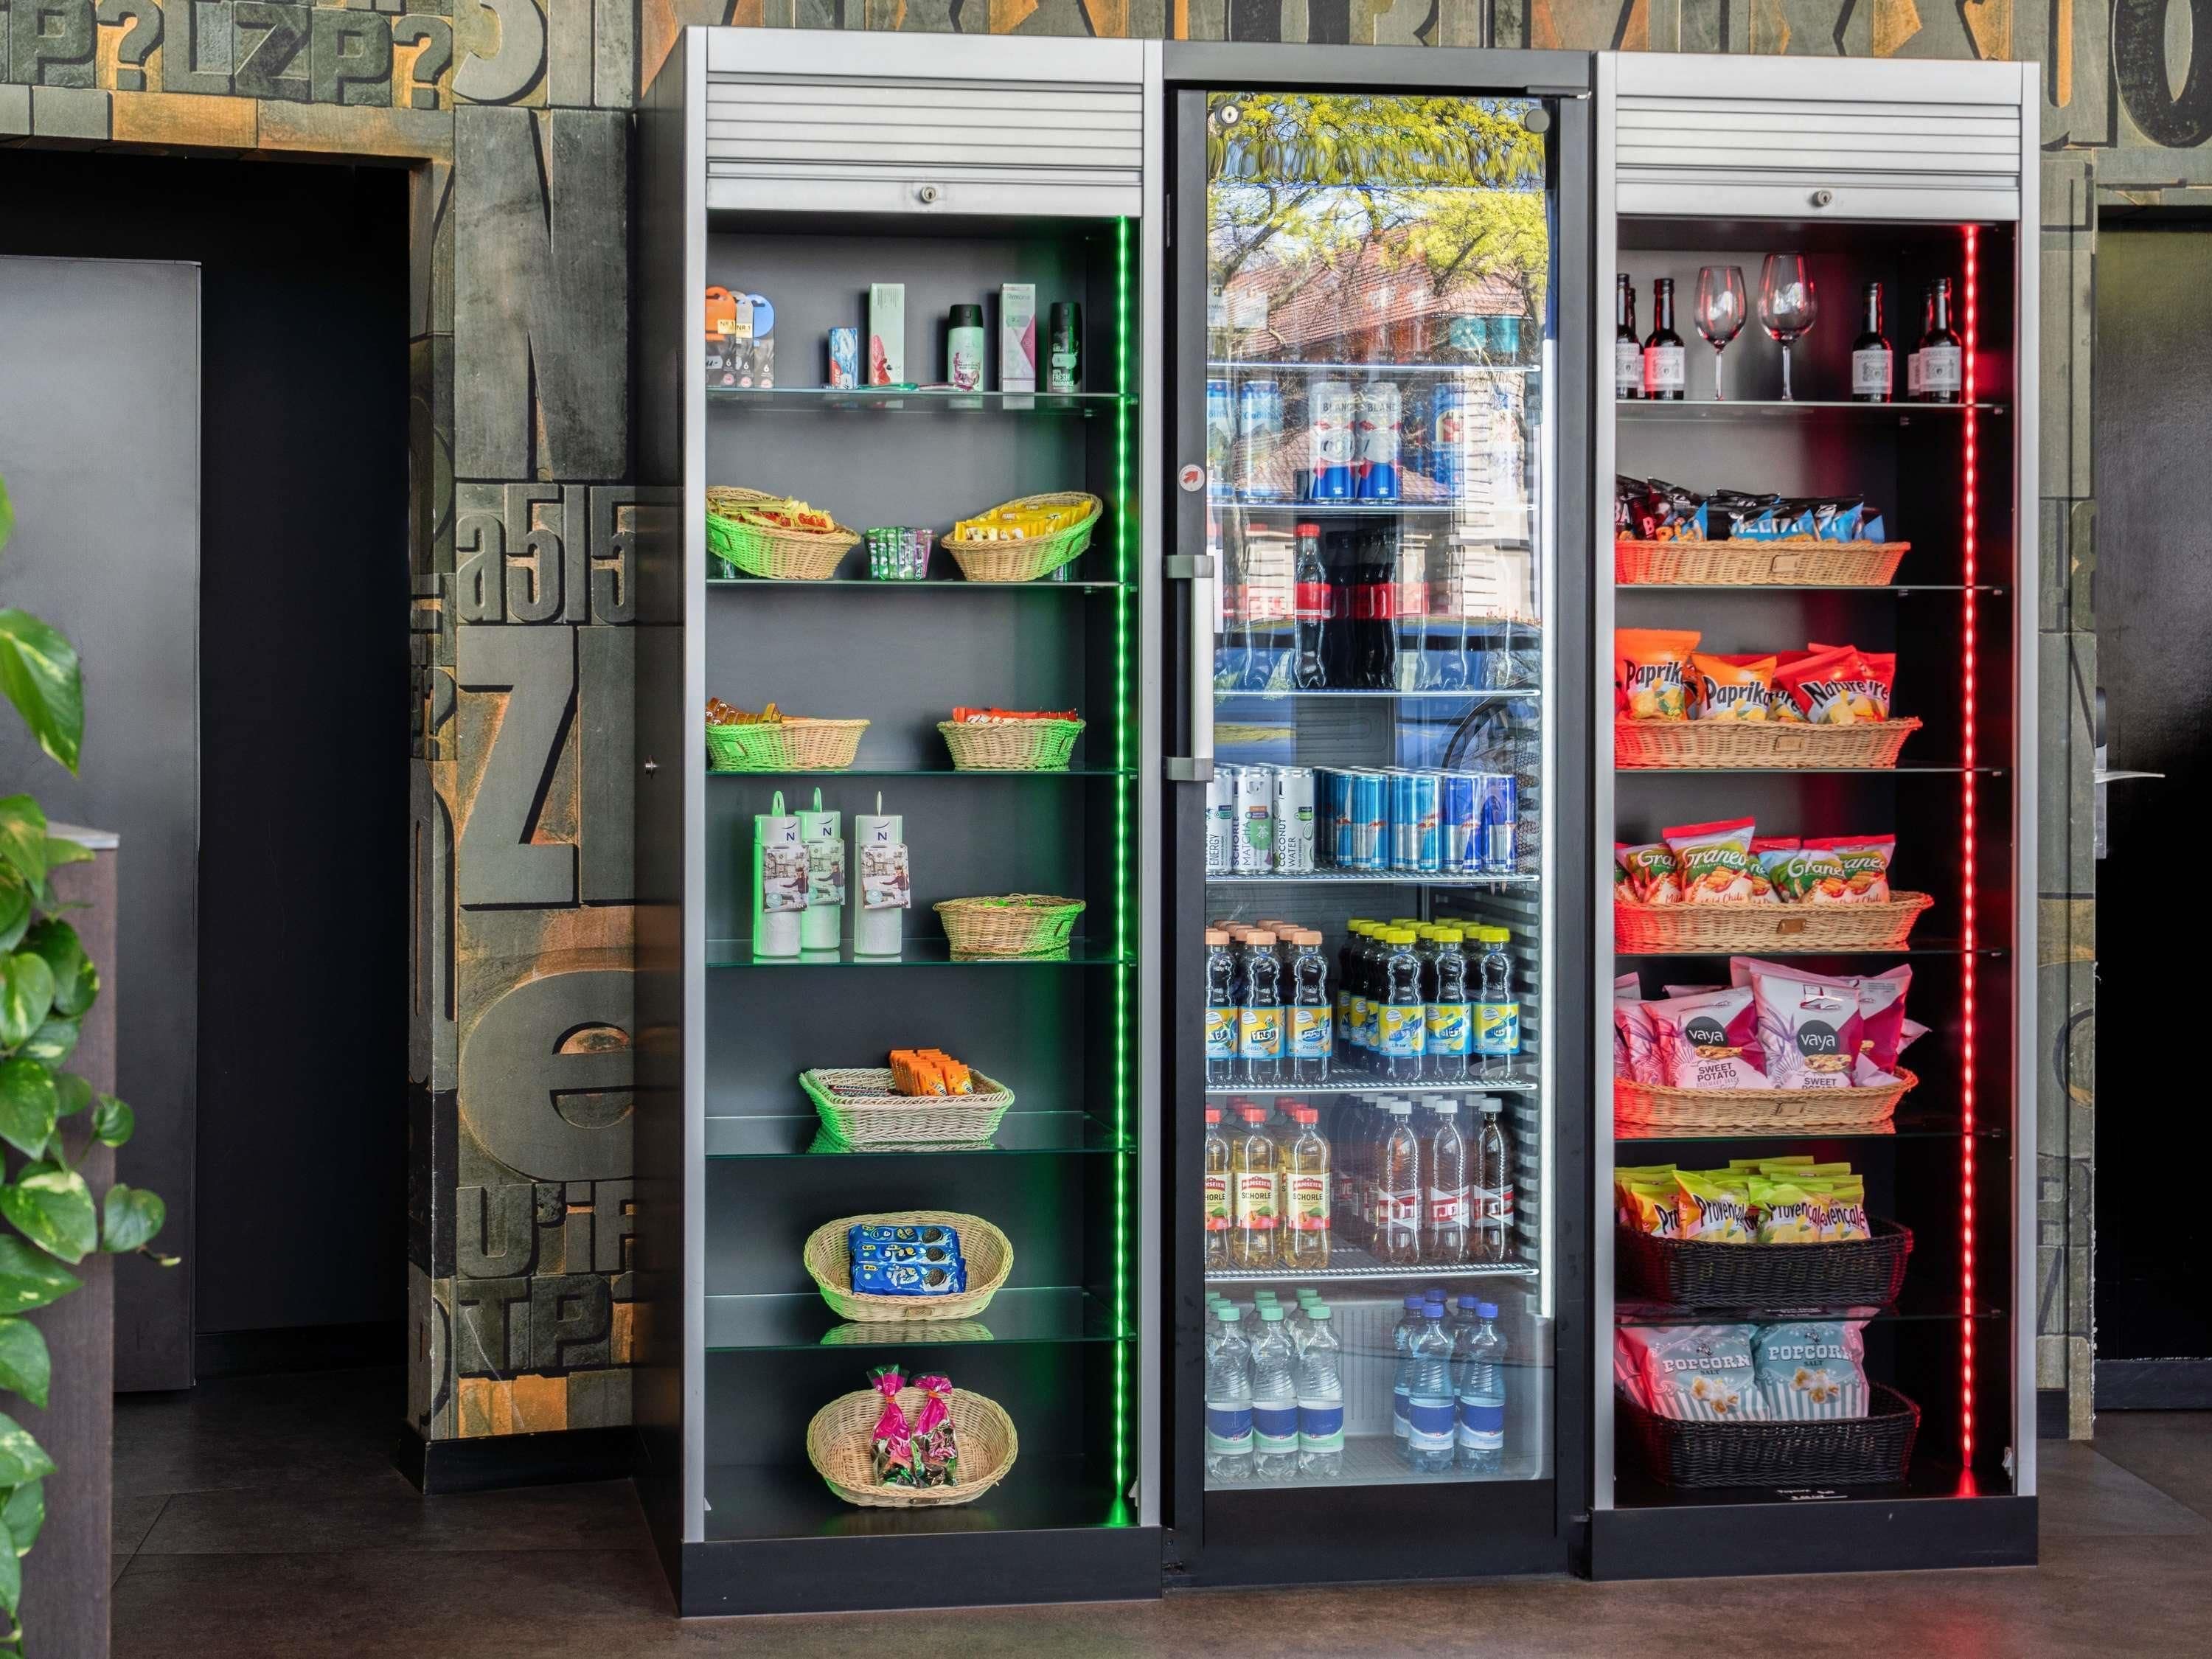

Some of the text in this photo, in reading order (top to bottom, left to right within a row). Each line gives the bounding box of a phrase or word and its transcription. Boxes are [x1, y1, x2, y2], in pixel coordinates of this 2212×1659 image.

[743, 361, 750, 369] 6
[763, 364, 770, 372] 6
[1209, 834, 1220, 866] ENERGY
[1242, 821, 1251, 866] MATCHA
[1279, 818, 1287, 867] COCONUT
[1288, 837, 1296, 867] WATER
[1688, 1029, 1724, 1044] vaya
[1800, 1034, 1836, 1051] vaya
[1697, 1069, 1737, 1082] POTATO
[1698, 1062, 1733, 1074] SWEET
[1804, 1077, 1837, 1086] SWEET
[1242, 1192, 1272, 1200] SCHORLE
[1293, 1192, 1324, 1200] SCHORLE
[1769, 1344, 1853, 1361] POPCORN
[1663, 1354, 1751, 1374] POPCORN
